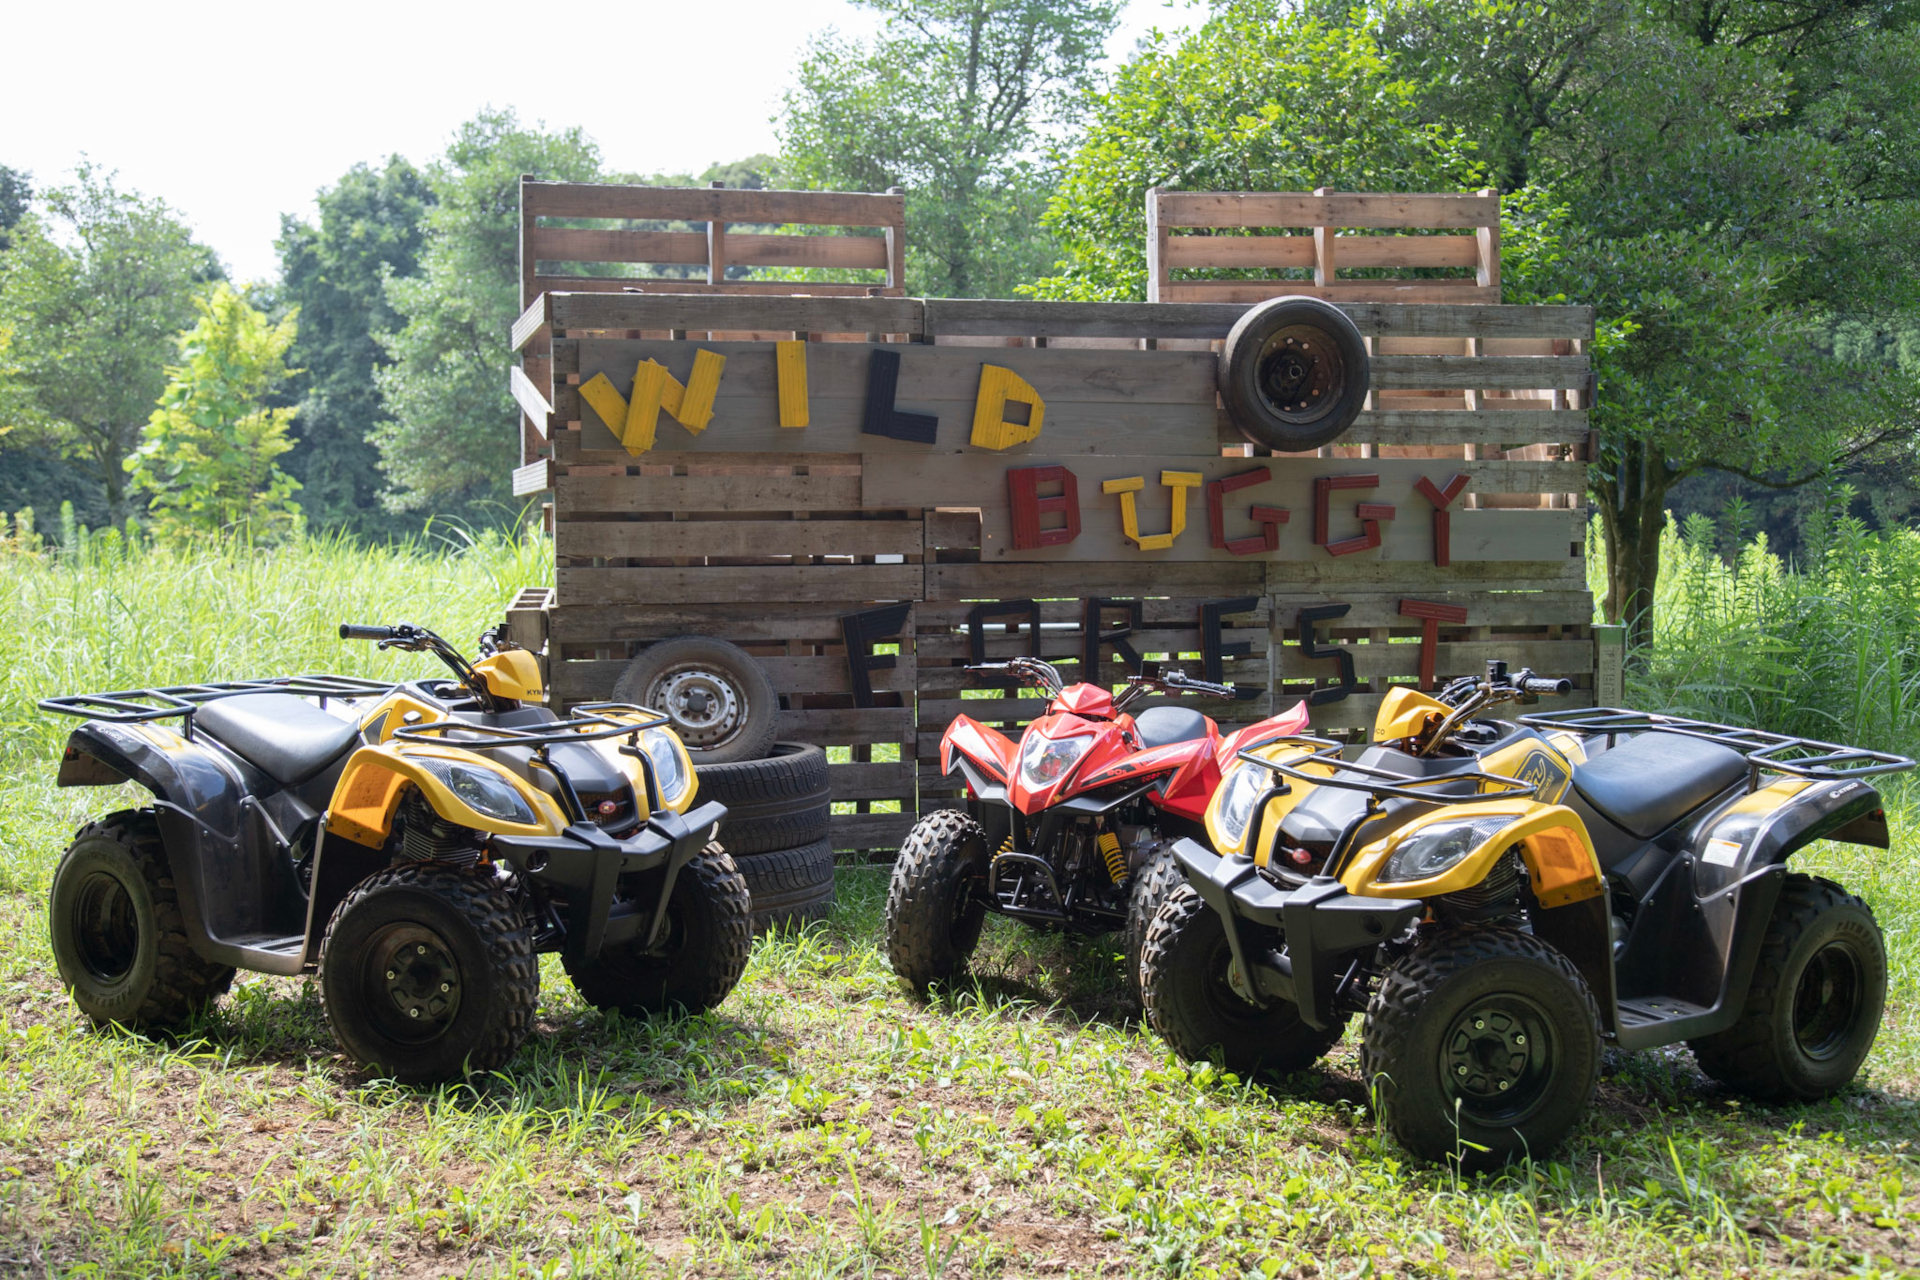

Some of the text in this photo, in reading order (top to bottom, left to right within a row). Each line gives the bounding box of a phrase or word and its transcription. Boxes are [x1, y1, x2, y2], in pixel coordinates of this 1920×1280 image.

[578, 340, 1046, 457] WILD
[1007, 465, 1471, 567] BUGGY
[840, 596, 1468, 709] FOREST
